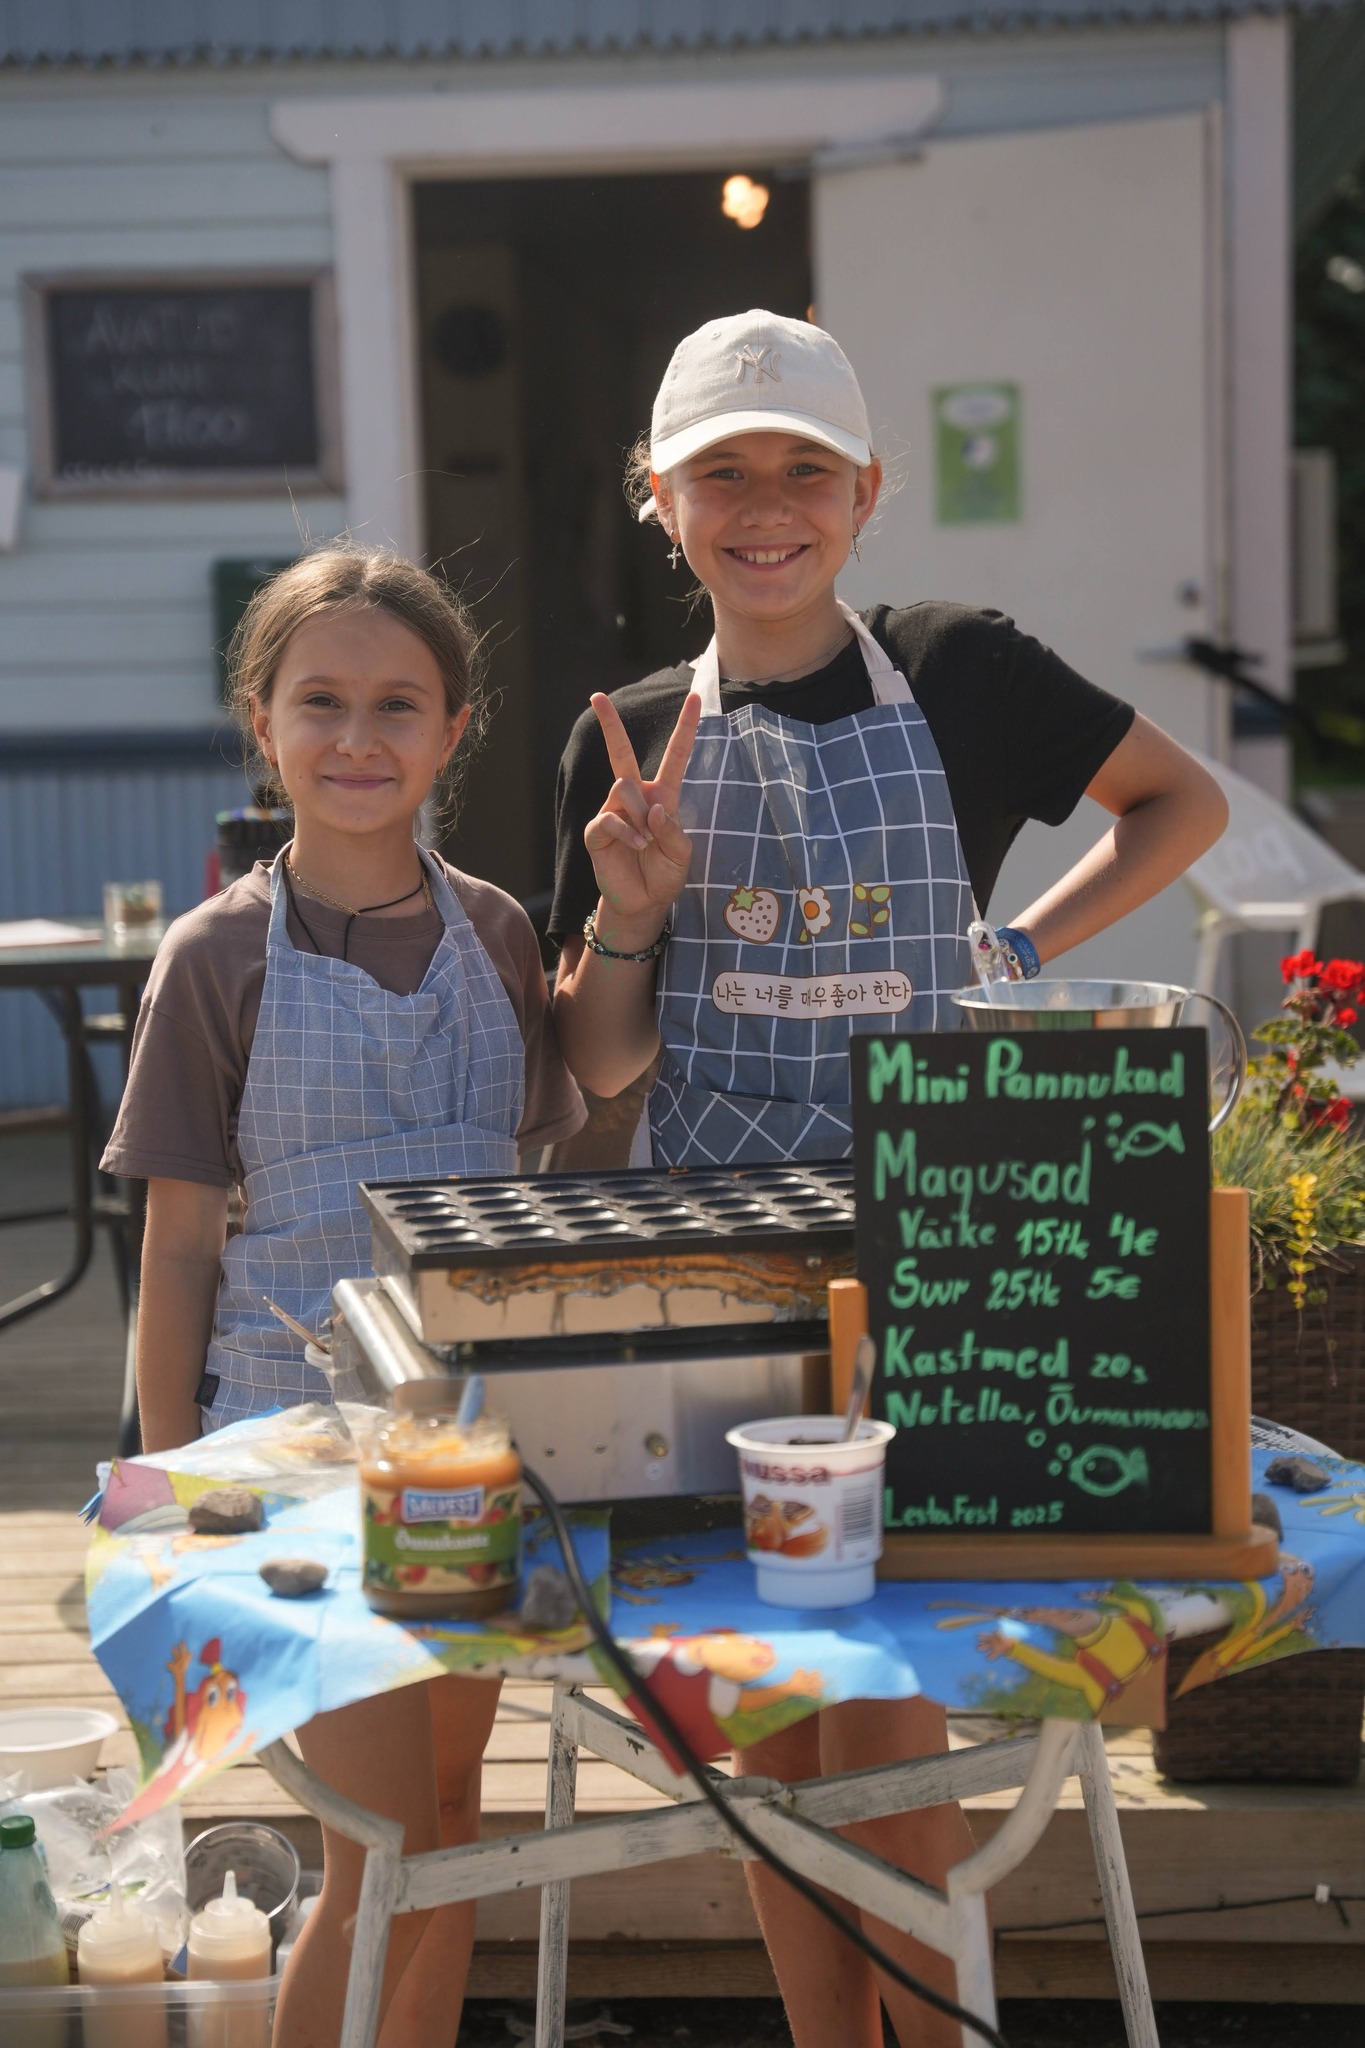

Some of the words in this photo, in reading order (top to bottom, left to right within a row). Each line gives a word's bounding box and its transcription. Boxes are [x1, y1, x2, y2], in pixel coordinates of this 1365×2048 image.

[734, 343, 782, 384] NY
[716, 980, 747, 1006] 나는
[755, 984, 794, 1010] 너를
[868, 1039, 969, 1104] Mini
[985, 1037, 1185, 1100] Pannukad
[873, 1129, 1092, 1222] Magusad
[1109, 1212, 1159, 1257] 4€
[888, 1256, 970, 1310] Suur
[985, 1267, 1062, 1311] 25tk
[1085, 1265, 1142, 1300] 5€
[884, 1325, 1069, 1379] Kastmed
[1010, 1501, 1064, 1527] 2025
